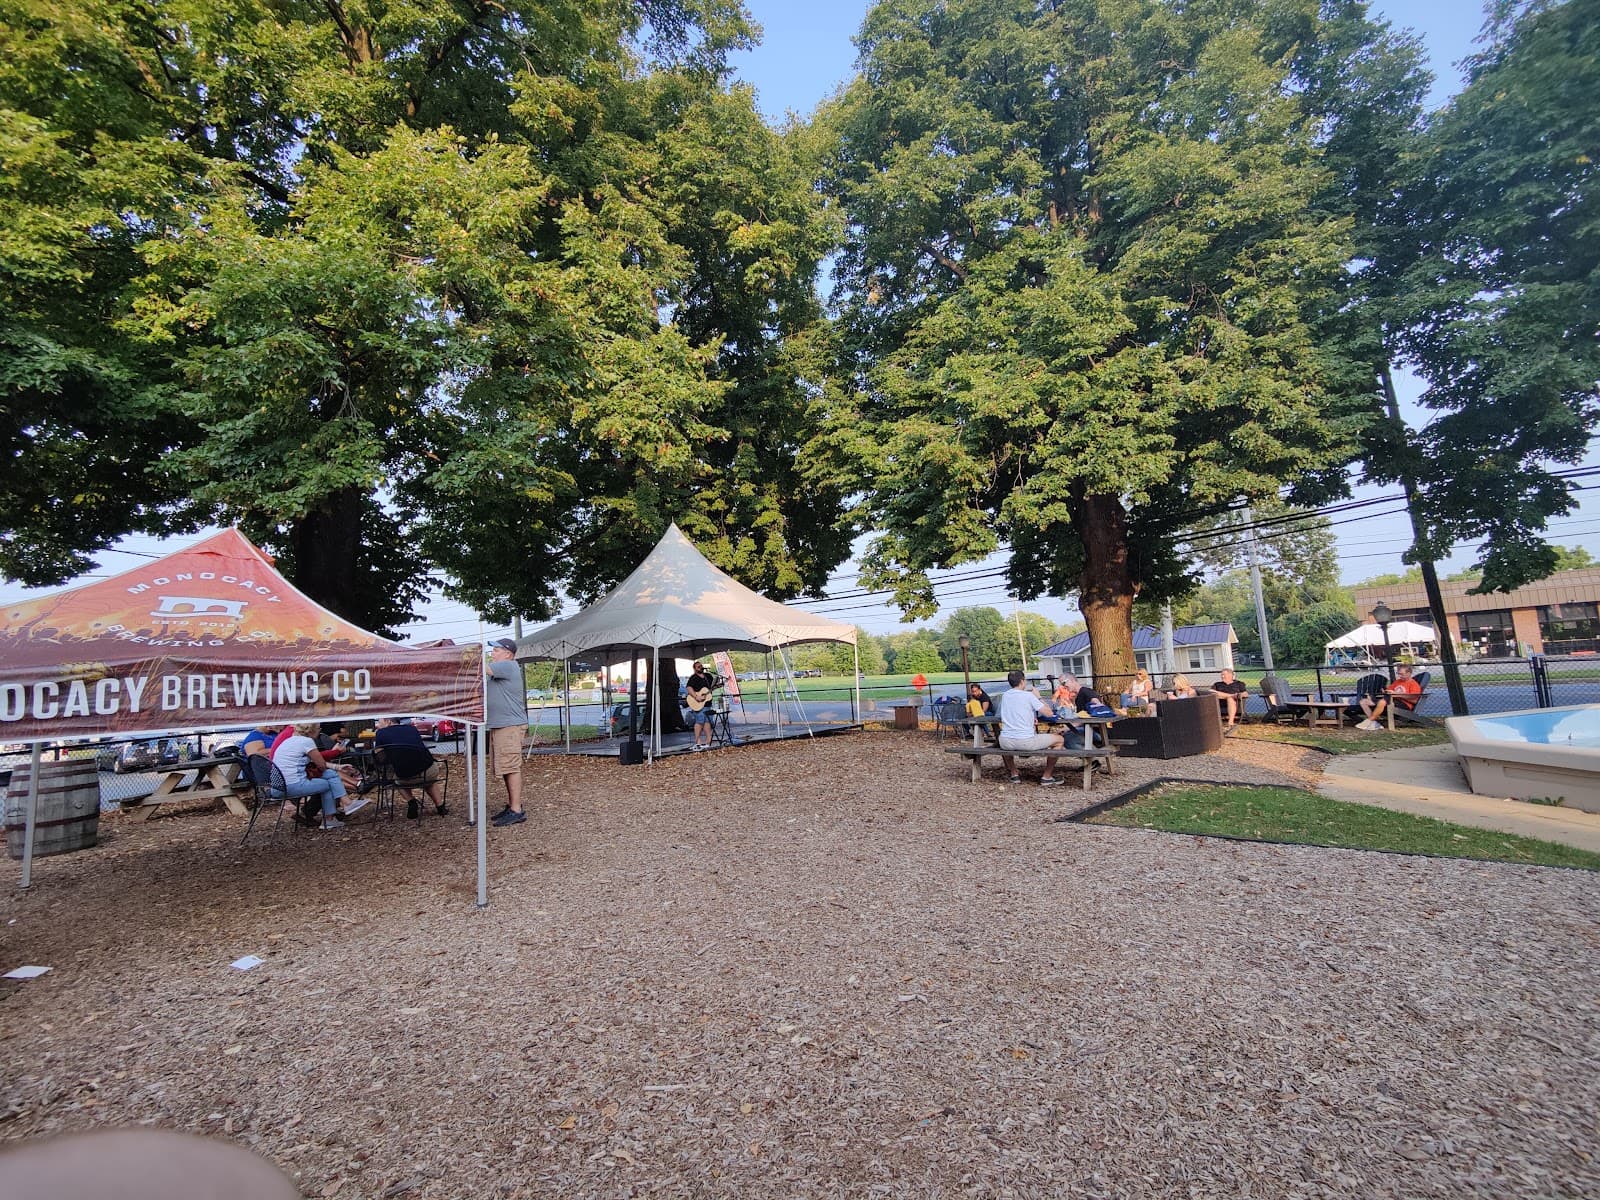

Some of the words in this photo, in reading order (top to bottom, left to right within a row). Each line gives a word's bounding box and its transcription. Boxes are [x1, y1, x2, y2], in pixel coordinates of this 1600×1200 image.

[127, 572, 281, 602] MONOCACY
[107, 624, 225, 647] BREWING
[0, 677, 148, 721] OCACY
[161, 671, 319, 711] BREWING
